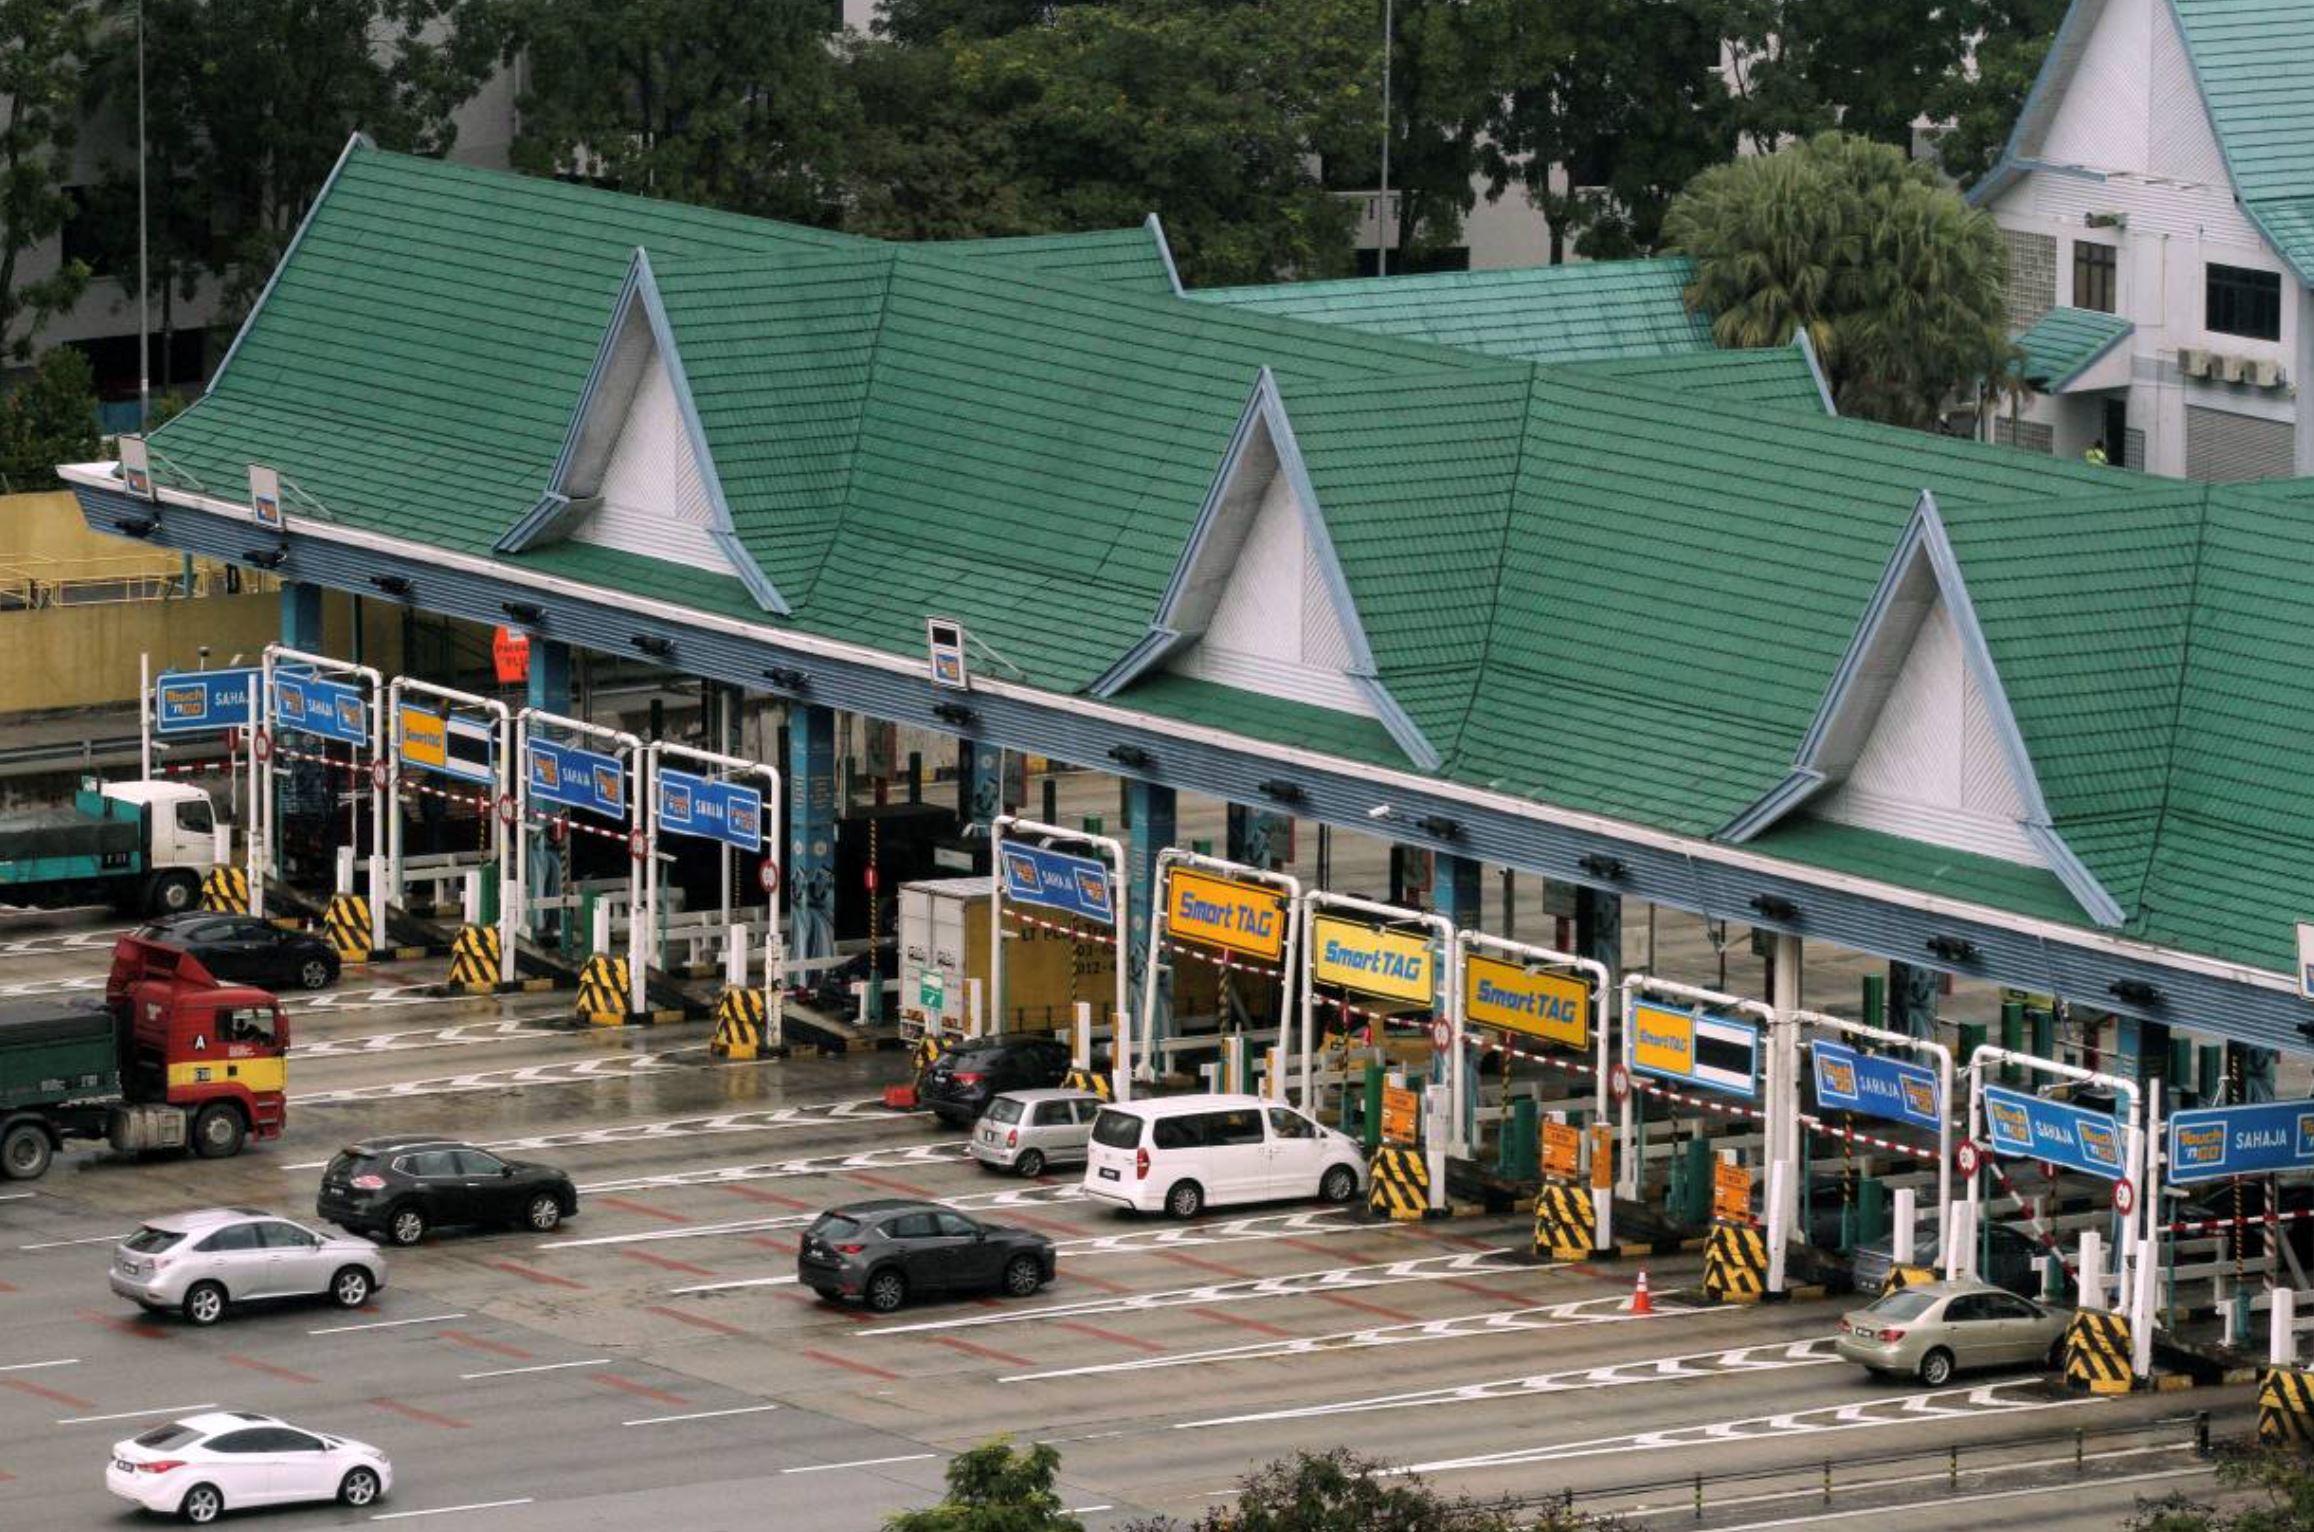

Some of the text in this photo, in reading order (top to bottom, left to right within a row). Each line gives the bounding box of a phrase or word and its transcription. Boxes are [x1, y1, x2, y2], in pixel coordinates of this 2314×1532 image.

[1179, 891, 1274, 938] Smart TAG
[194, 1034, 206, 1051] A
[2235, 1128, 2288, 1150] SAHAJA
